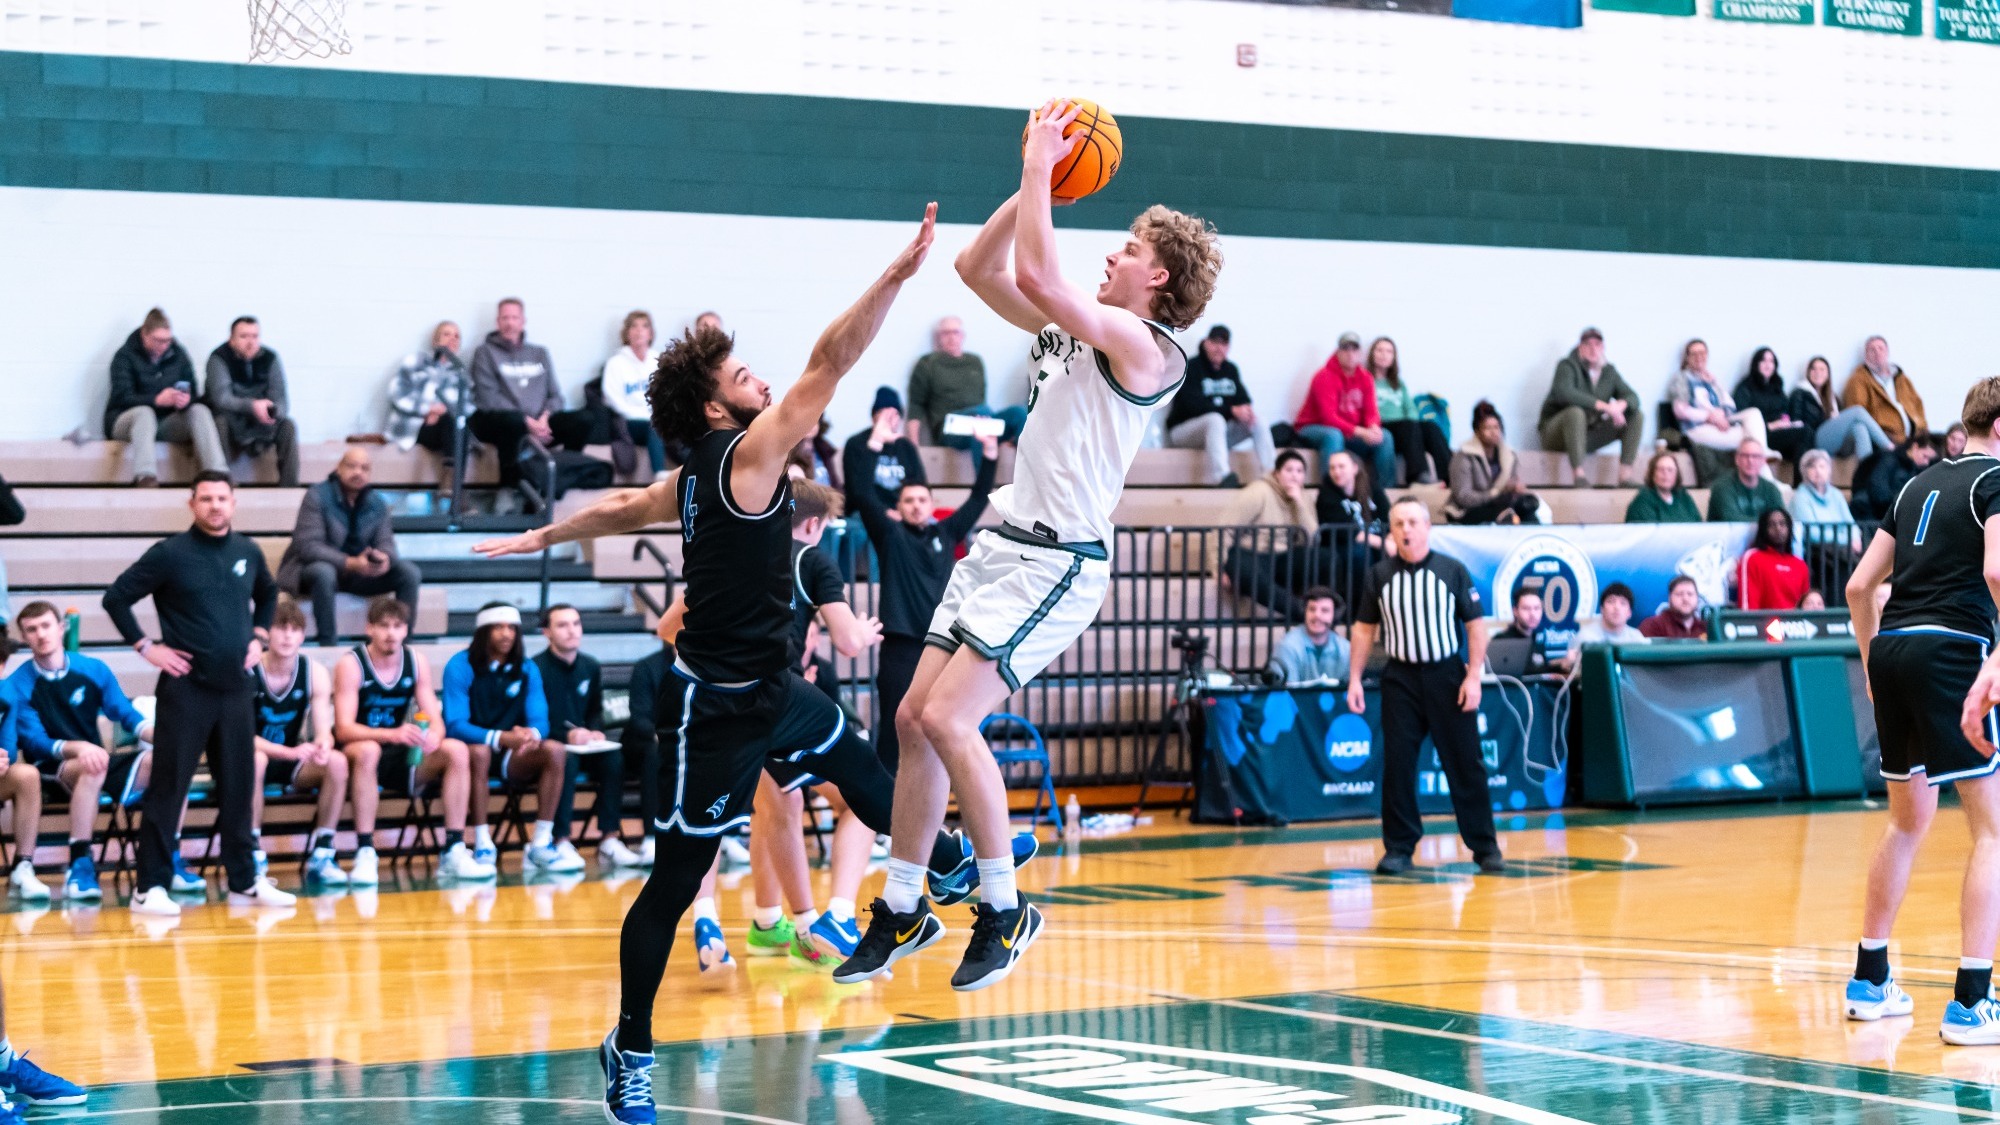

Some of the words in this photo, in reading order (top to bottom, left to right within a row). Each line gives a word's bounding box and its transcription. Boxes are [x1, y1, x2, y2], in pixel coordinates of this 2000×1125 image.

[1721, 2, 1801, 20] CHAMPIONS
[1836, 9, 1906, 31] CHAMPIONS
[1031, 330, 1063, 362] LAKE
[675, 475, 698, 542] 4
[1913, 489, 1940, 546] 1
[1330, 740, 1370, 758] NCAA
